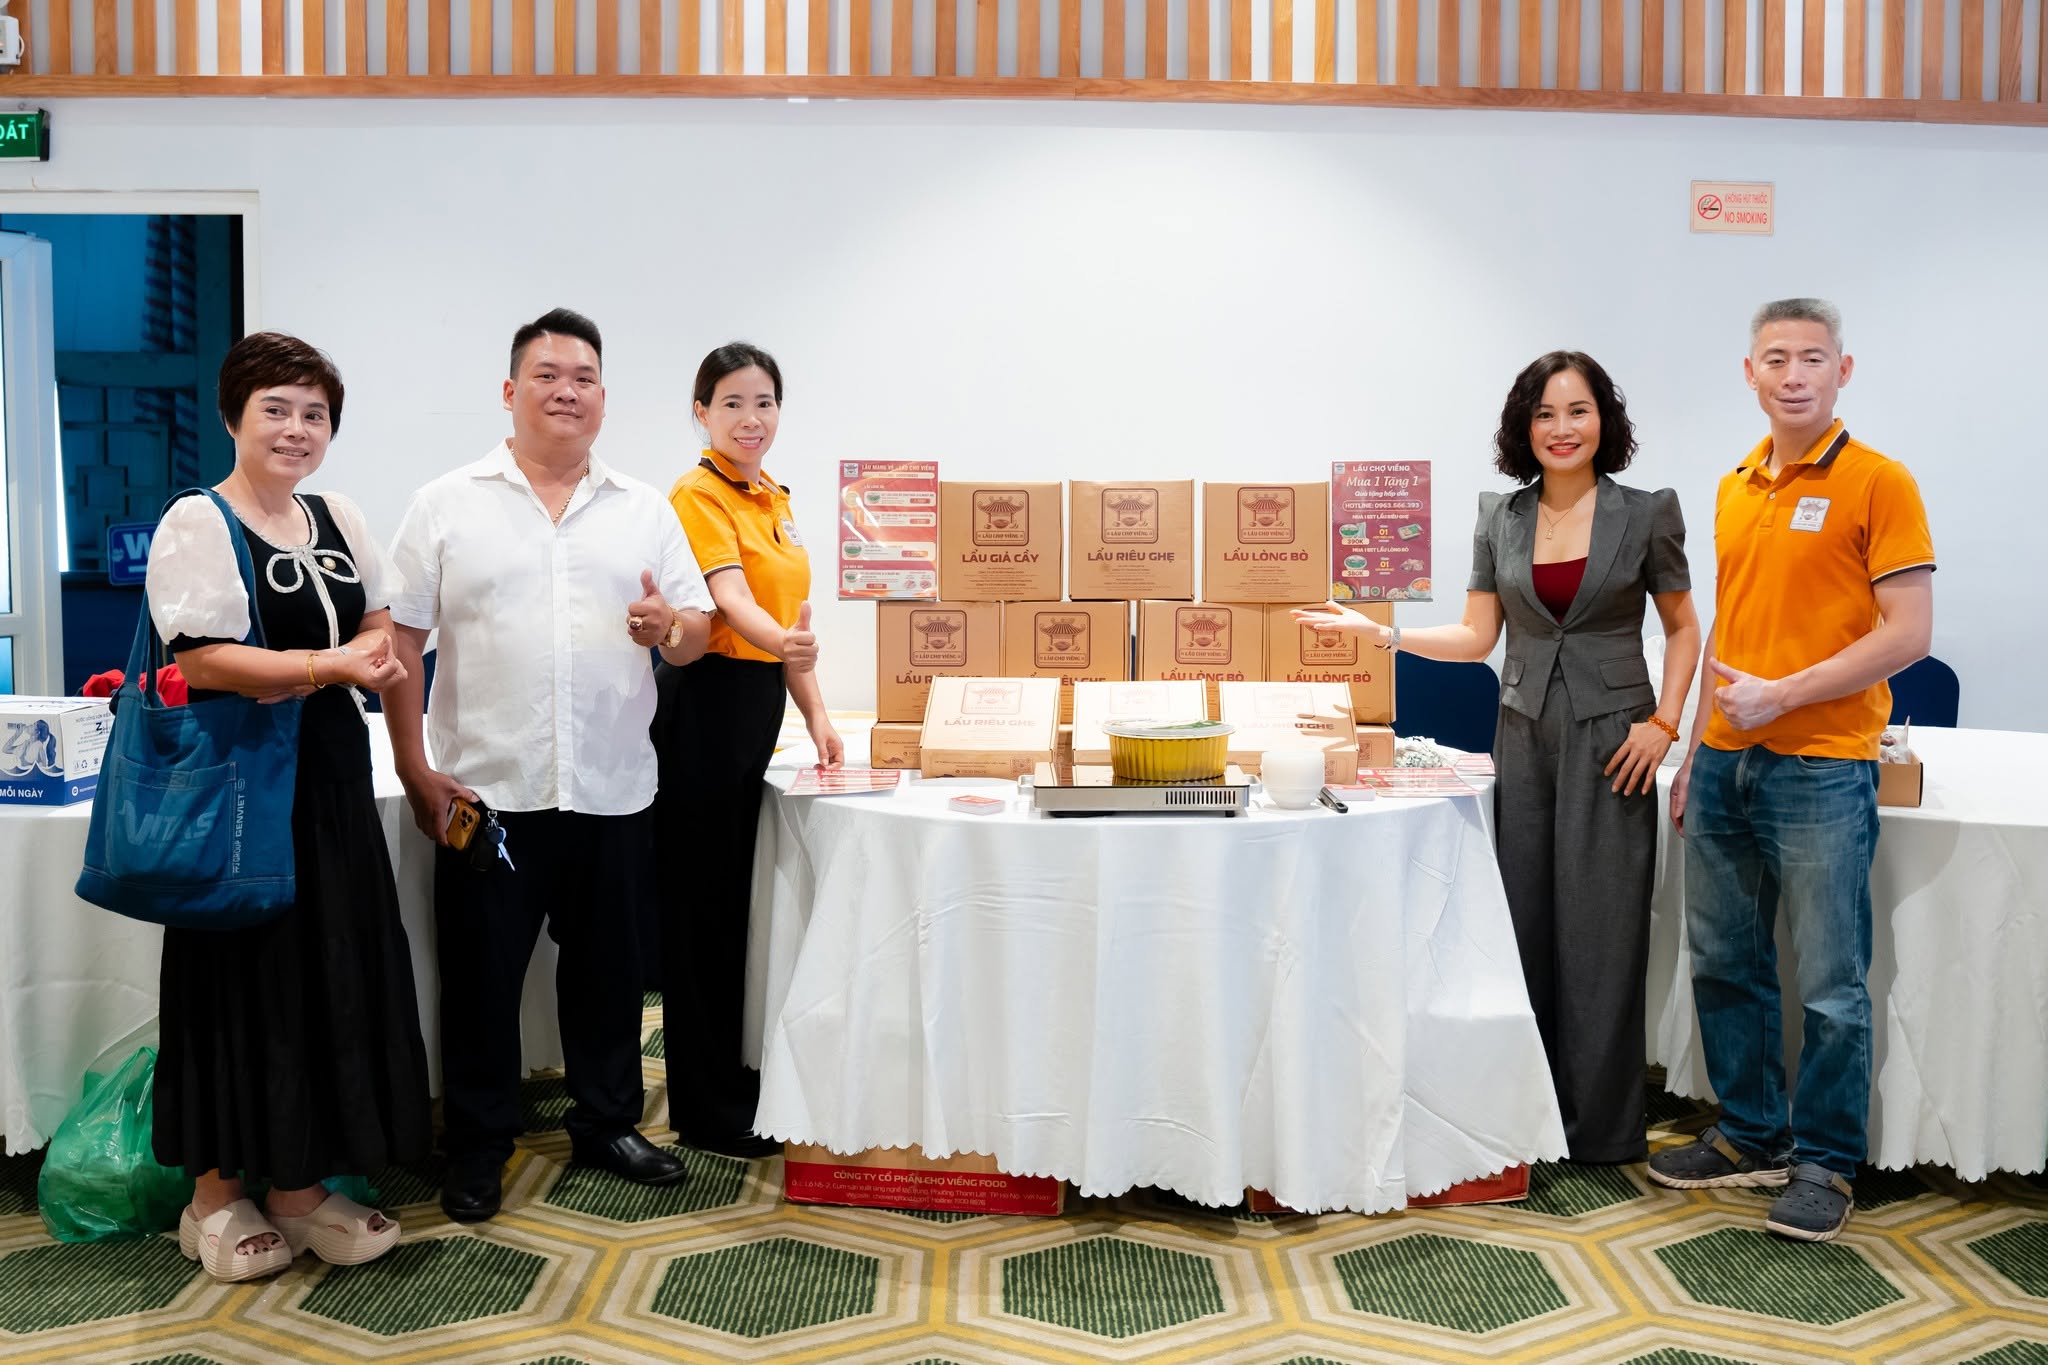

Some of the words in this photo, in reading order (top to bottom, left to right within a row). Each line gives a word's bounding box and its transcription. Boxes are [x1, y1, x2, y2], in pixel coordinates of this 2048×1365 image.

[1724, 212, 1735, 224] NO
[1736, 212, 1768, 224] SMOKING
[1369, 464, 1386, 473] CHỢ
[1346, 476, 1371, 487] Mua
[1374, 476, 1380, 487] 1
[1384, 476, 1409, 488] Tặng
[1412, 476, 1418, 486] 1
[962, 549, 987, 563] LẨU
[990, 551, 1011, 563] GIẢ
[1014, 549, 1039, 563] CẦY
[1088, 547, 1113, 561] LẨU
[1116, 549, 1146, 561] RIÊU
[1149, 552, 1175, 563] GHẸ
[1224, 547, 1249, 561] LẨU
[1252, 549, 1288, 561] LÒNG
[1290, 549, 1308, 561] BÒ
[896, 670, 921, 684] LẨU
[1161, 667, 1186, 680] LẨU
[1189, 670, 1224, 681] LÒNG
[1226, 670, 1244, 682] BÒ
[1287, 669, 1311, 682] LẨU
[1315, 671, 1350, 682] LÒNG
[1353, 670, 1371, 683] BÒ
[974, 717, 1005, 726] RIÊU
[0, 786, 16, 798] MỖI
[18, 788, 44, 798] NGÀY
[236, 794, 245, 838] GENVIET
[834, 1171, 861, 1180] CÔNG
[878, 1171, 892, 1182] CỔ
[979, 1180, 1007, 1188] FOOD
